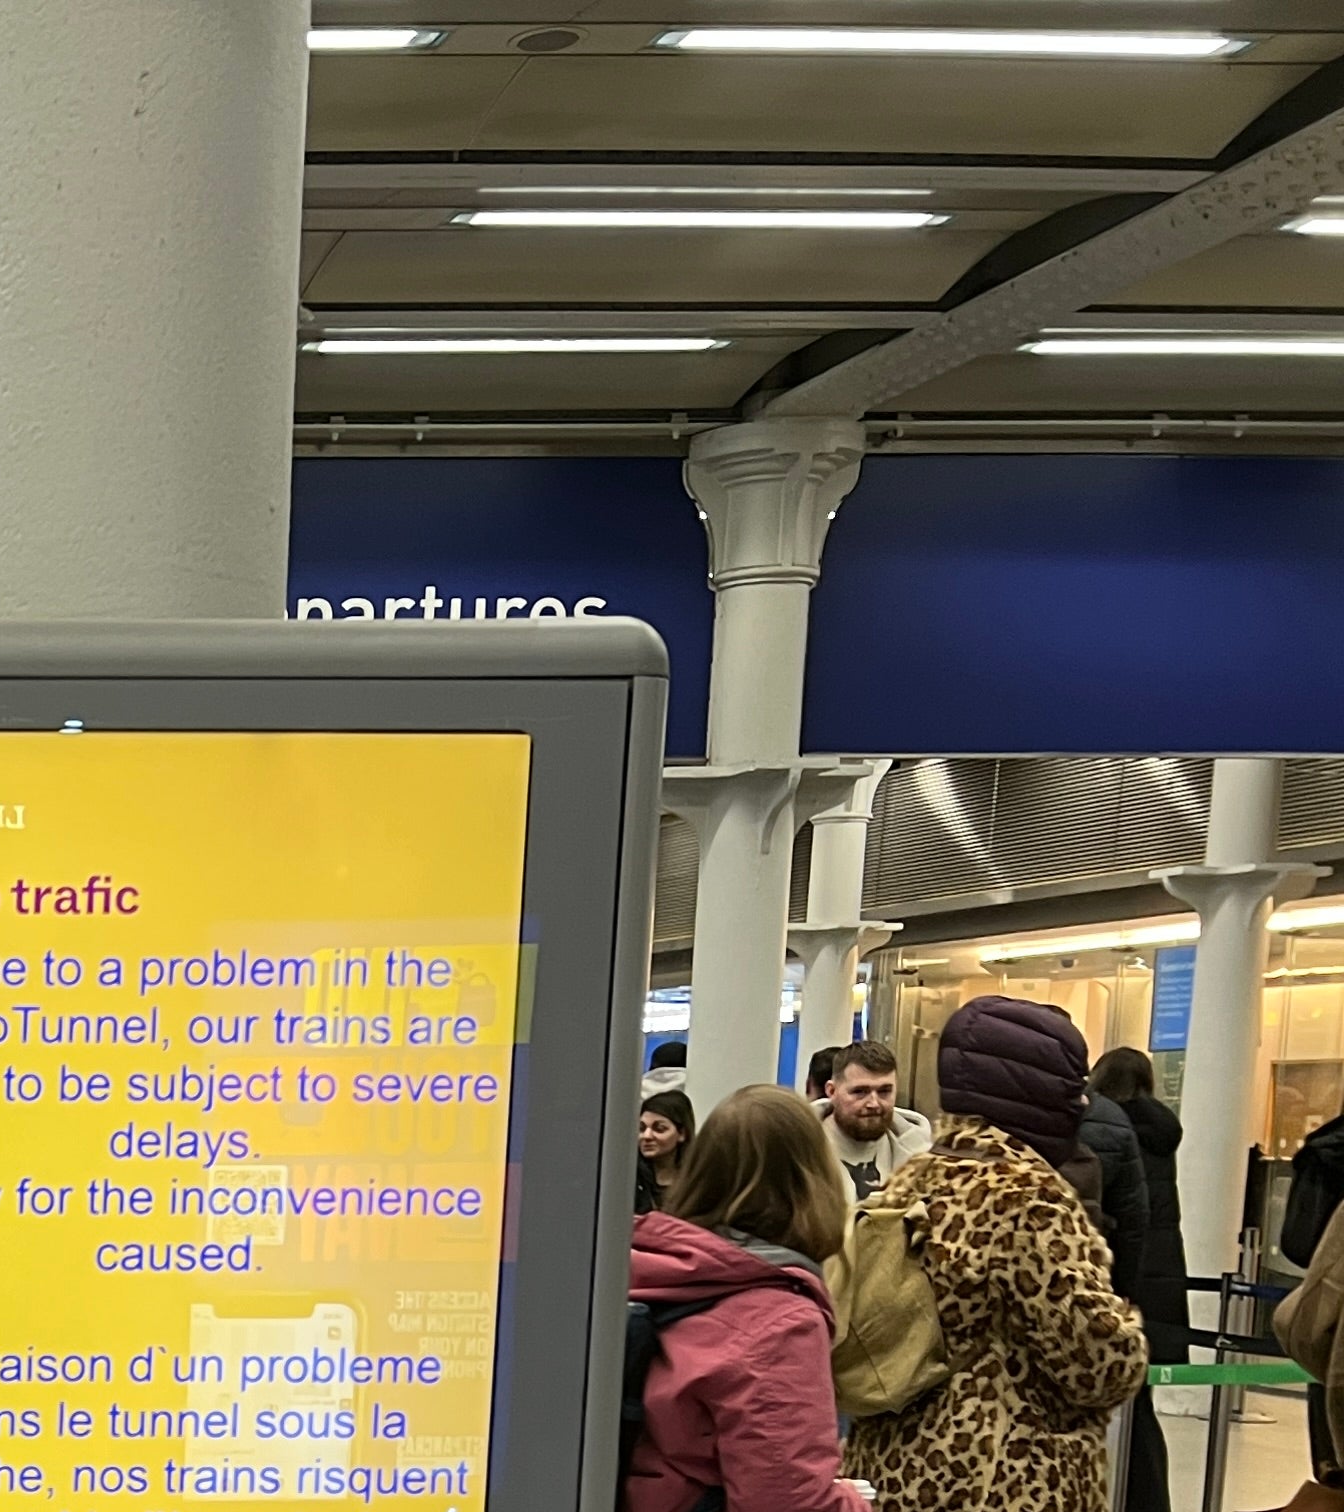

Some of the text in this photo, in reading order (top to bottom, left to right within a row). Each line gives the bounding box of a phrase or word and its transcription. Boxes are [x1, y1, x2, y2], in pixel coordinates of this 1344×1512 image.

[11, 874, 141, 916] trafic
[43, 949, 83, 987] to
[98, 957, 123, 987] a
[139, 948, 315, 995] problem
[333, 950, 368, 987] in
[385, 950, 452, 988] the
[187, 1015, 260, 1046] our
[273, 1007, 392, 1046] trains
[408, 1015, 478, 1046] are
[3, 1065, 43, 1103] to
[59, 1063, 111, 1103] be
[127, 1064, 282, 1113] subject
[298, 1067, 336, 1104] to
[354, 1073, 500, 1104] severe
[109, 1121, 262, 1170] delays.
[15, 1176, 74, 1216] for
[86, 1177, 154, 1216] the
[169, 1177, 483, 1217] inconvenience
[95, 1235, 263, 1273] caused.
[239, 1347, 443, 1392] probleme
[57, 1400, 93, 1438] le
[108, 1402, 240, 1440] tunnel
[254, 1410, 356, 1440] sous
[371, 1402, 407, 1440] la
[73, 1465, 149, 1494] nos
[163, 1459, 281, 1496] trains
[295, 1458, 470, 1506] risquent
